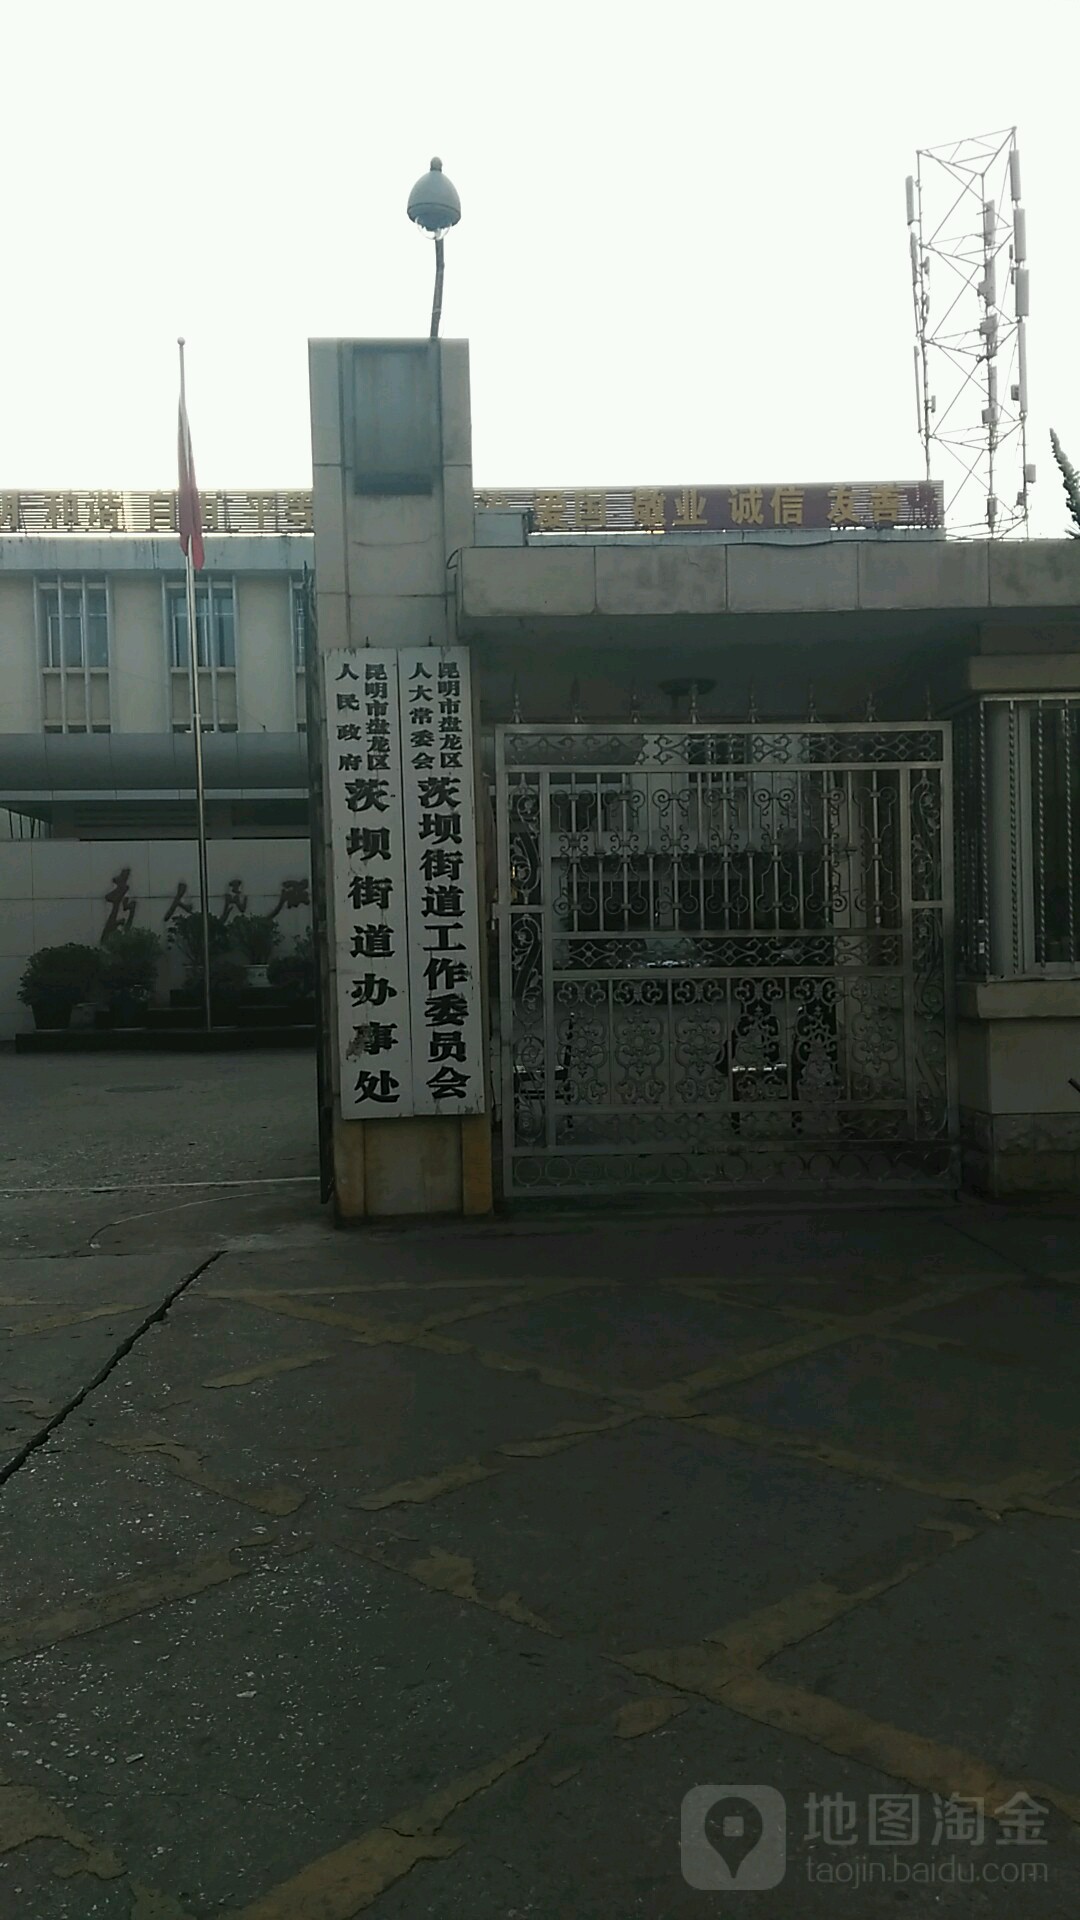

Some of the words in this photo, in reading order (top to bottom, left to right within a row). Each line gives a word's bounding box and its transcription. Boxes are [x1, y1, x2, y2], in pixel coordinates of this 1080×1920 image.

[534, 490, 605, 527] 爱国
[632, 488, 707, 525] 敬业
[728, 486, 804, 524] 诚信
[827, 484, 902, 523] 友善
[335, 663, 362, 771] 人民政府
[365, 663, 391, 770] 昆明市盘龙区
[408, 662, 435, 770] 人大常委会
[438, 662, 463, 769] 昆明市盘龙区
[345, 778, 400, 1103] 茨坝街道办事处
[417, 777, 471, 1099] 茨坝街道工作委员会
